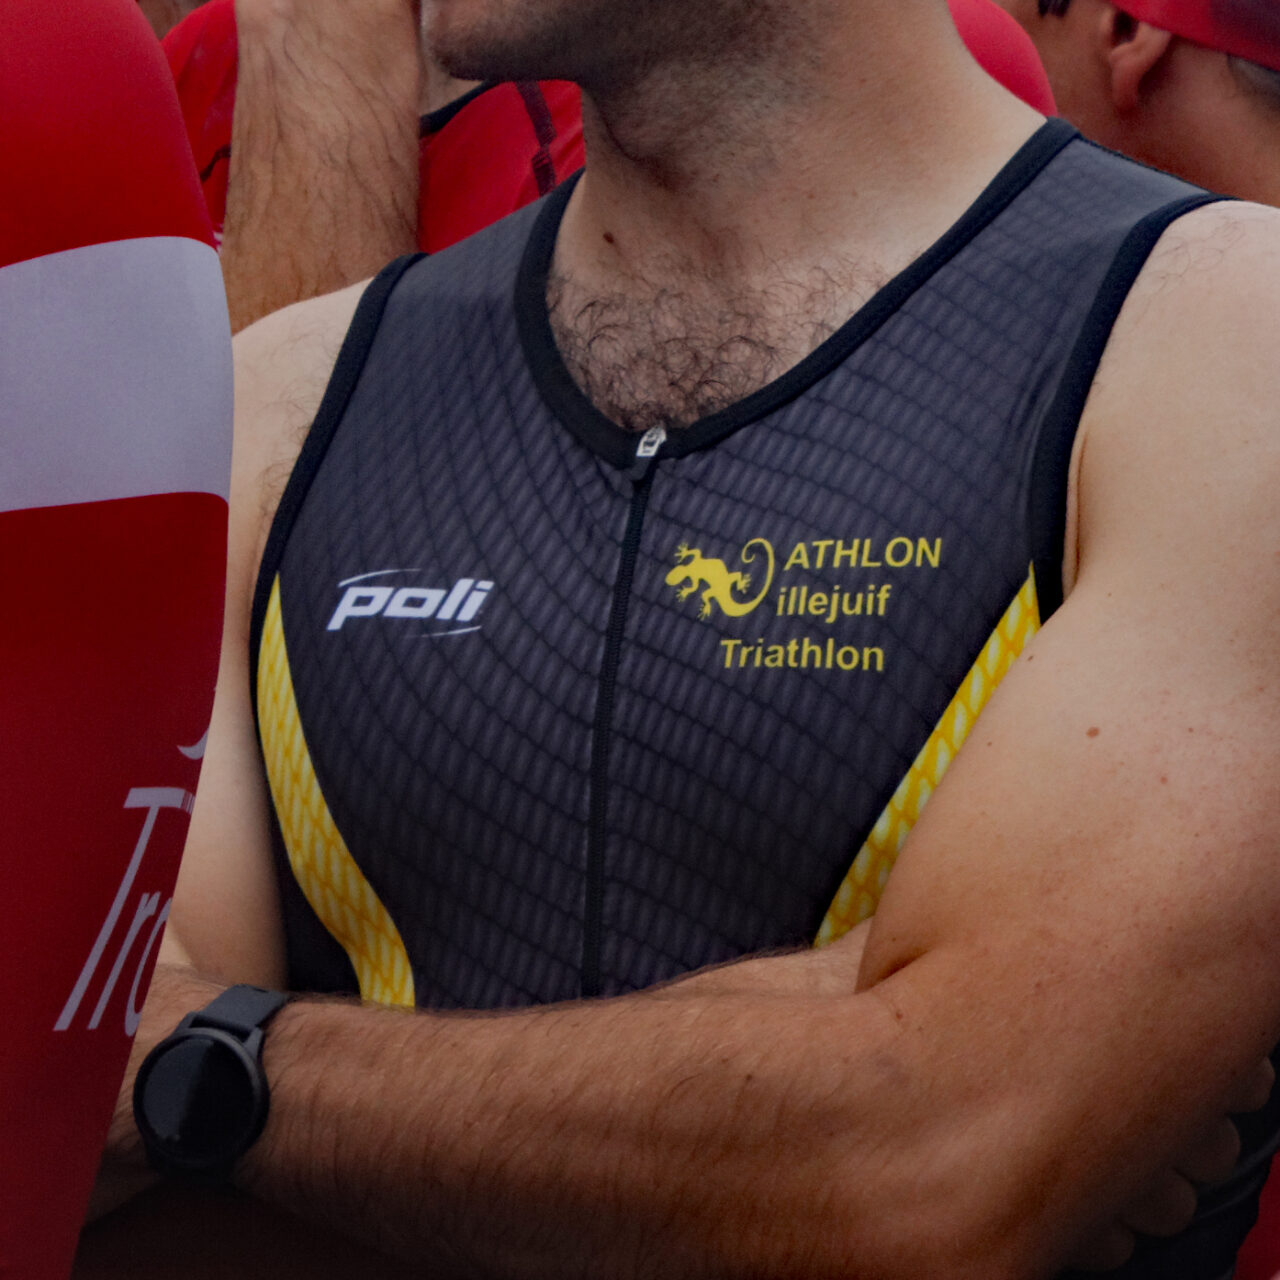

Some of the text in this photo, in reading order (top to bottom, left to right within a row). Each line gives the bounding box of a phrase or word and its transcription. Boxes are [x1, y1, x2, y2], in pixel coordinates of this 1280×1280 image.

[784, 537, 942, 571] ATHLON
[326, 578, 495, 632] poli
[777, 584, 893, 624] illejuif
[720, 637, 885, 671] Triathlon
